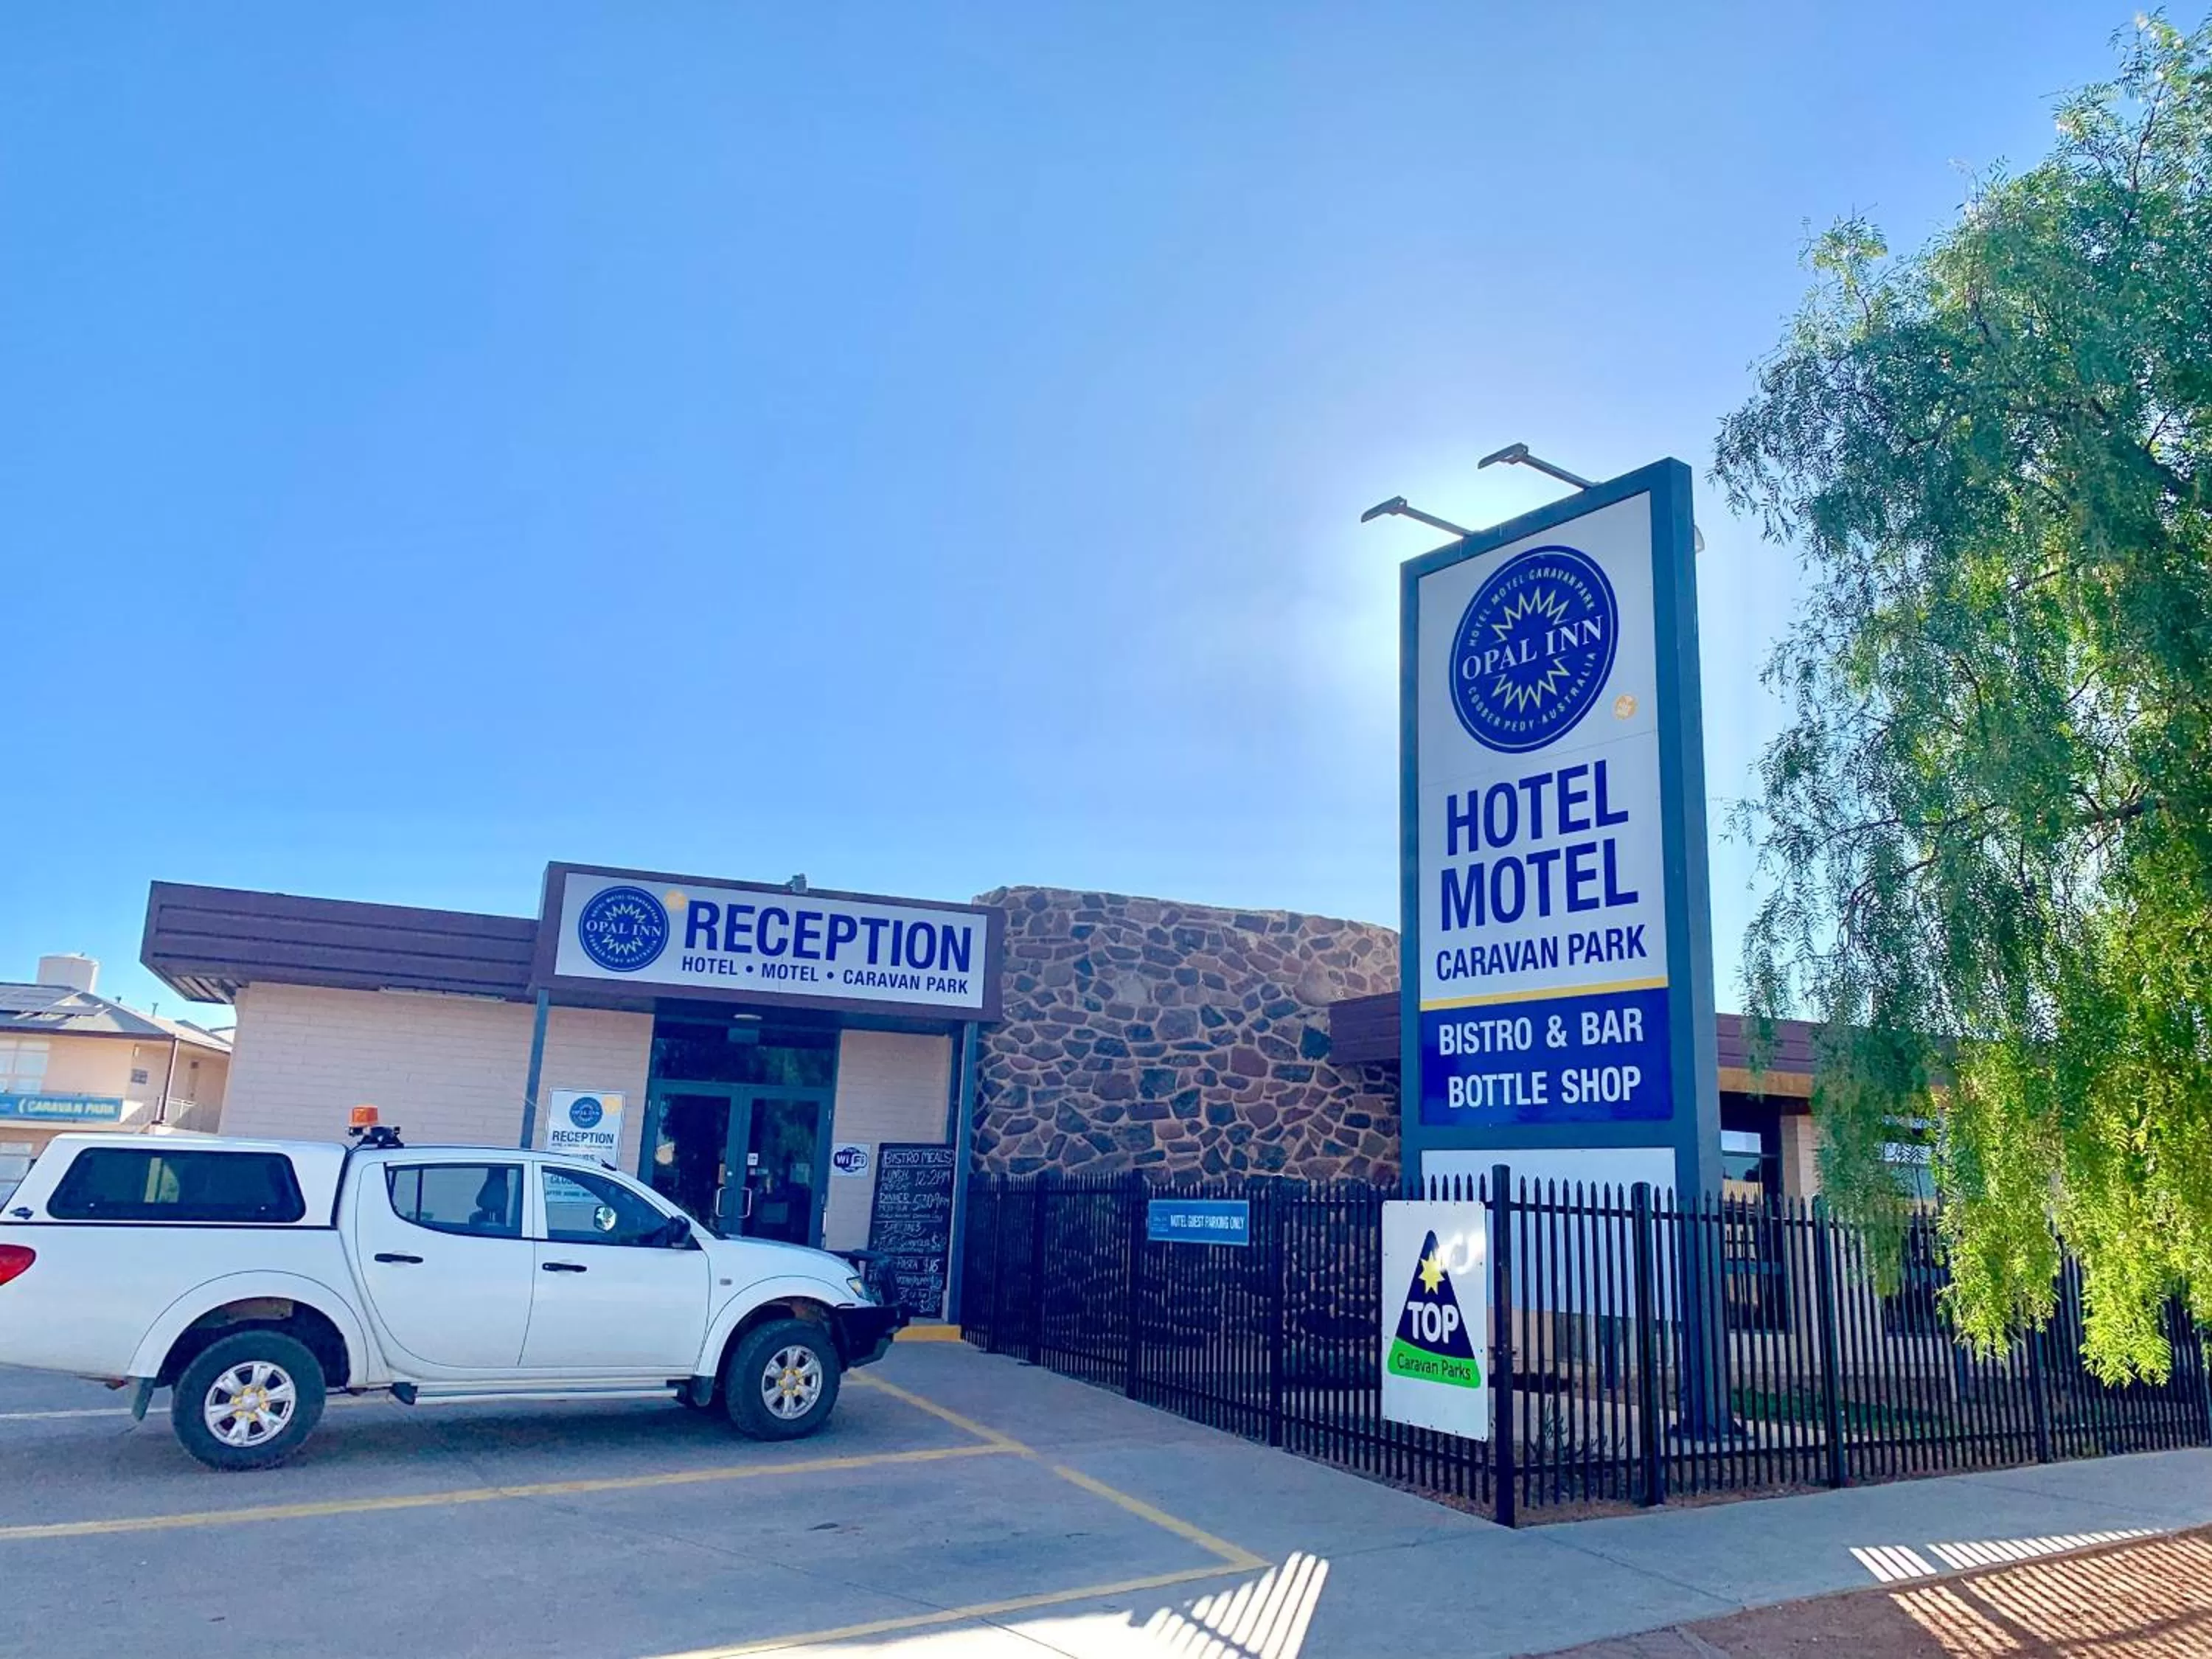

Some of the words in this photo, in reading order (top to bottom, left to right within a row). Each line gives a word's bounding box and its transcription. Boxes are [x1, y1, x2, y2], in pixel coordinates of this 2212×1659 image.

[1470, 607, 1492, 647] HOTEL
[1490, 573, 1526, 606] MOTEL
[1574, 581, 1596, 611] PARK
[1461, 638, 1537, 681] OPAL
[1545, 615, 1604, 658] INN
[1467, 686, 1501, 727] COOBER
[1503, 718, 1535, 732] PEDY
[1541, 652, 1597, 725] AUSTRALIA
[1447, 759, 1629, 856] HOTEL
[1441, 838, 1638, 932] MOTEL
[586, 919, 629, 935] OPAL
[633, 924, 662, 937] INN
[684, 900, 972, 973] RECEPTION
[1436, 936, 1559, 981] CARAVAN
[1568, 924, 1648, 966] PARK
[682, 956, 738, 976] HOTEL
[762, 963, 818, 982] MOTEL
[843, 970, 921, 991] CARAVAN
[926, 975, 968, 995] PARK
[1439, 1017, 1533, 1055] BISTRO
[1546, 1015, 1568, 1048] &
[1581, 1008, 1644, 1046] BAR
[27, 1100, 82, 1114] CARAVAN
[85, 1102, 116, 1115] PARK
[1448, 1071, 1548, 1107] BOTTLE
[1561, 1065, 1641, 1103] SHOP
[552, 1130, 614, 1144] RECEPTION
[1170, 1214, 1186, 1228] MOTEL
[1188, 1214, 1203, 1228] GUEST
[1204, 1215, 1228, 1229] PARKING
[1230, 1216, 1245, 1230] ONLY
[1407, 1301, 1459, 1344] TOP
[1397, 1353, 1439, 1375] Caravan
[1441, 1360, 1471, 1381] Parks
